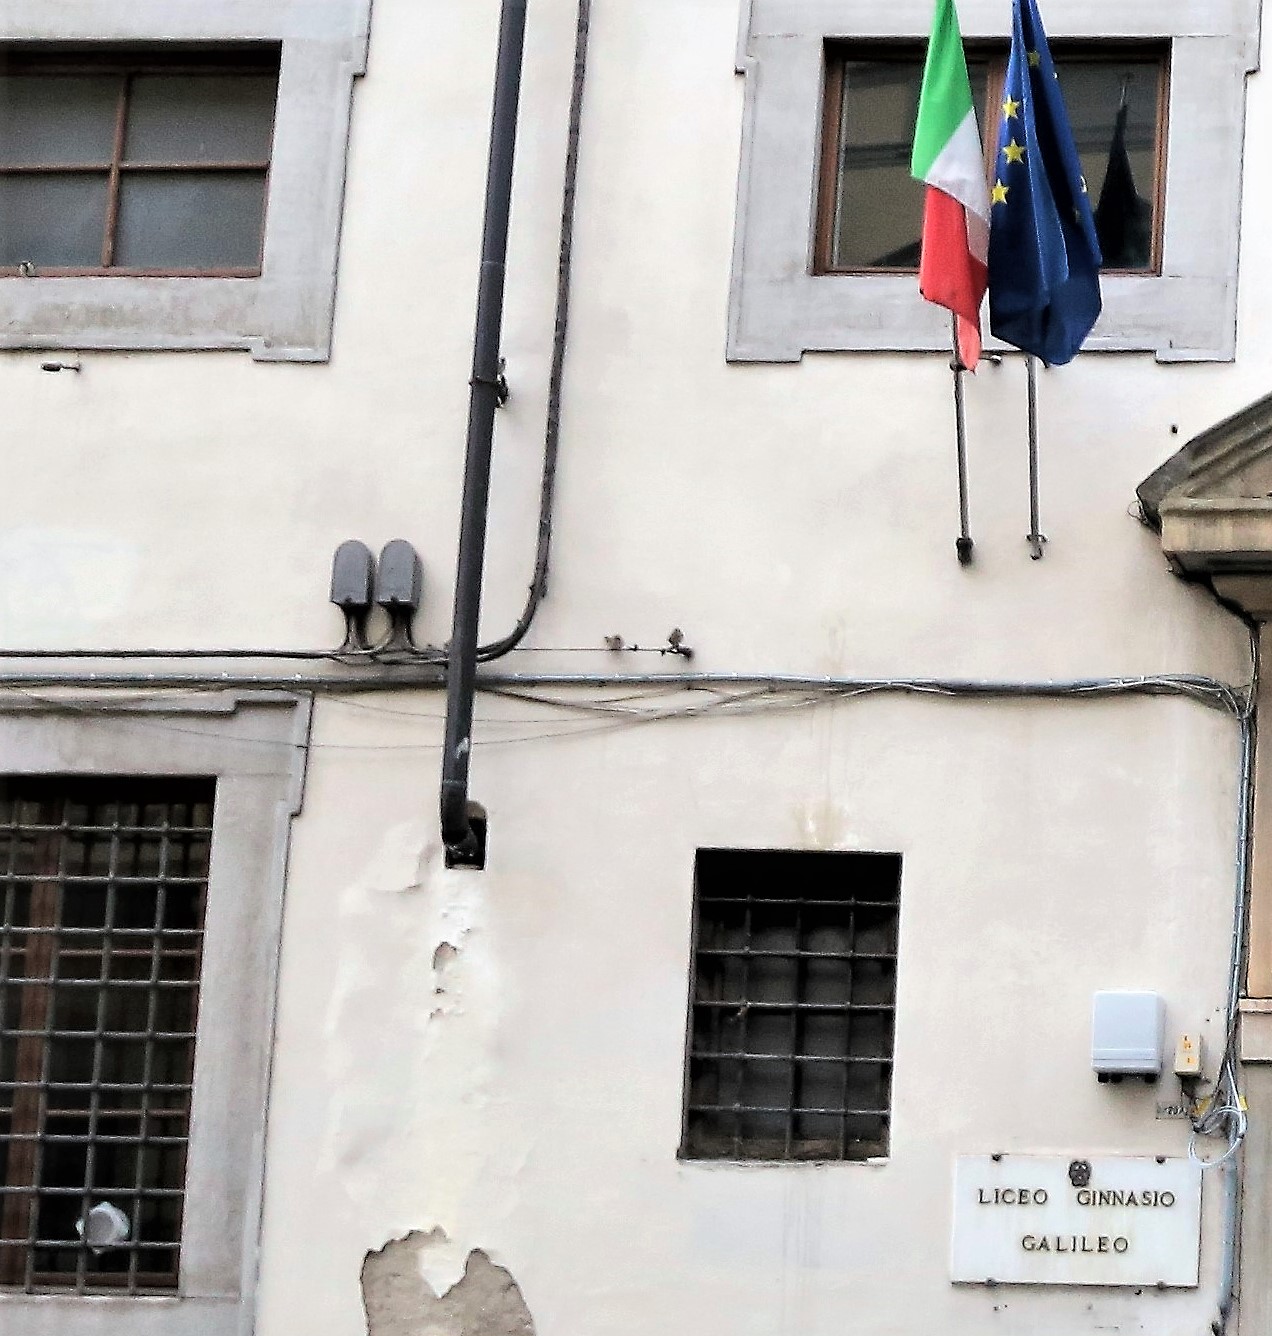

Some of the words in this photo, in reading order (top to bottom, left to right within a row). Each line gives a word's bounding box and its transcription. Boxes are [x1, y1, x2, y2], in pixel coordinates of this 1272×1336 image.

[978, 1188, 1048, 1205] LICEO
[1076, 1190, 1176, 1207] GINNASIO
[1022, 1235, 1129, 1253] GALILEO
